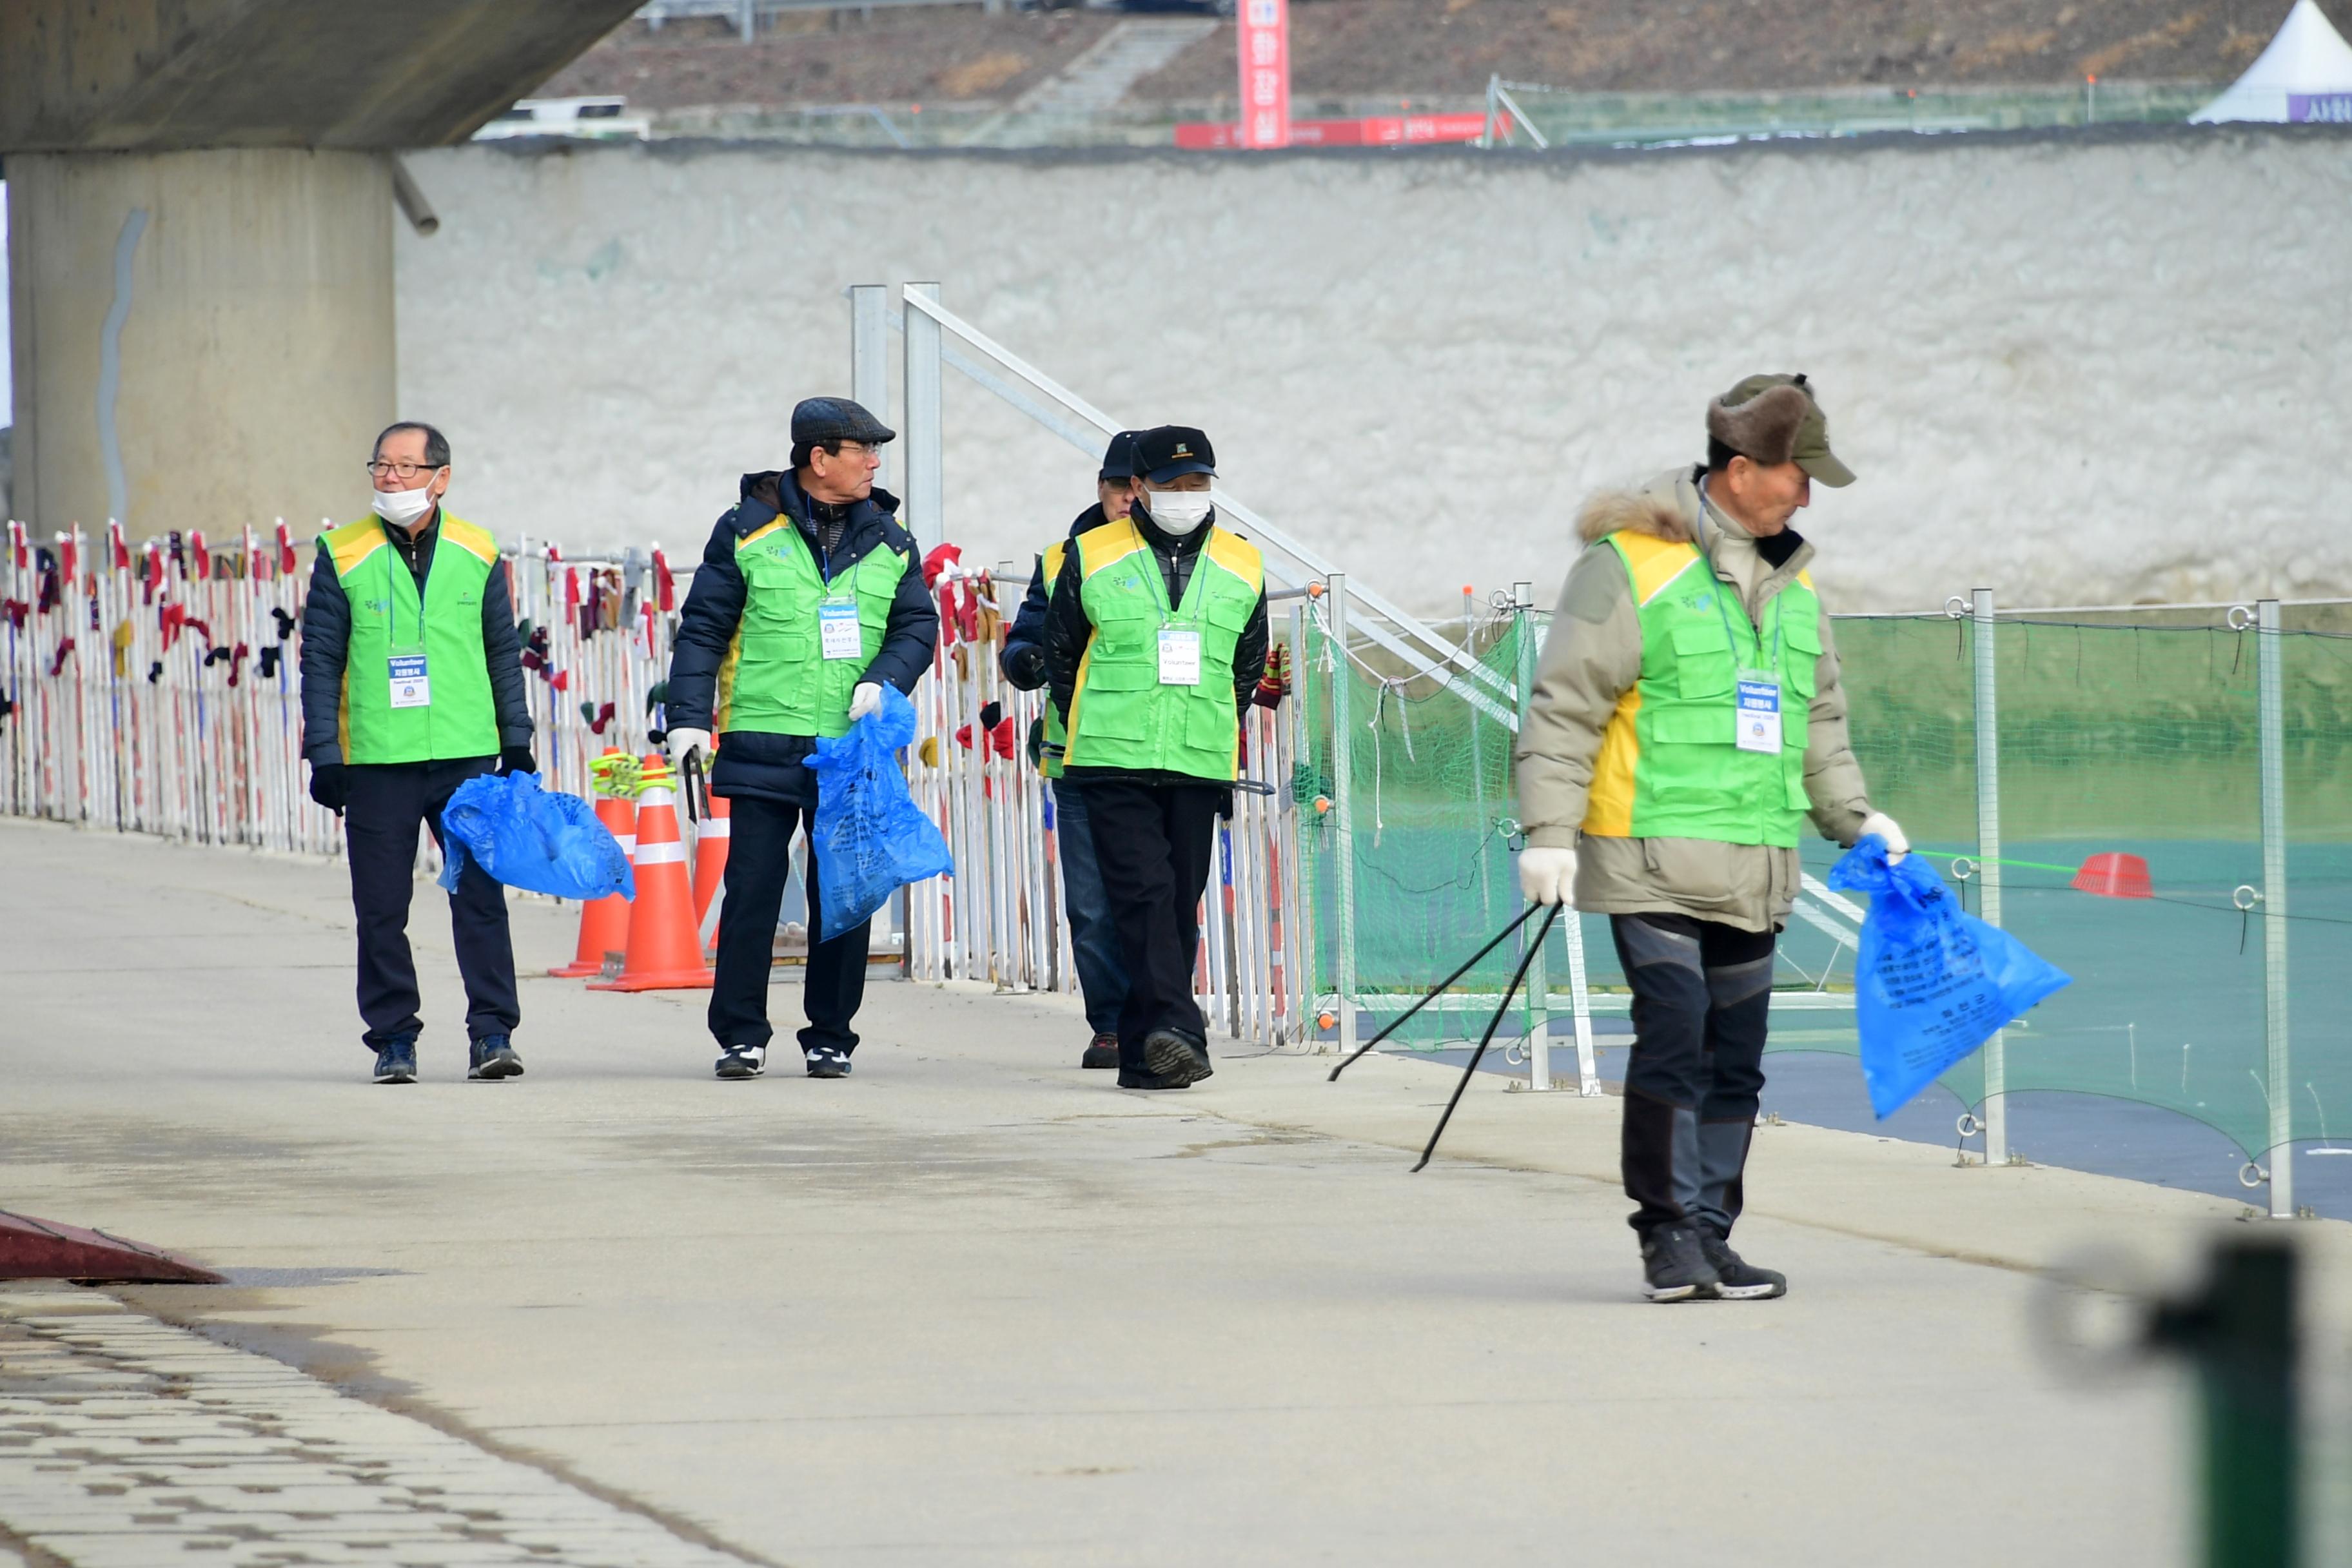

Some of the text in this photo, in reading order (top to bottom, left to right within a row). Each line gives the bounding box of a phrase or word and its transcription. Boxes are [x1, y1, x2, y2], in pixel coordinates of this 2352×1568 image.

[1251, 30, 1279, 144] 화장실
[390, 658, 425, 667] Volunteer
[1740, 684, 1778, 697] Volunteer
